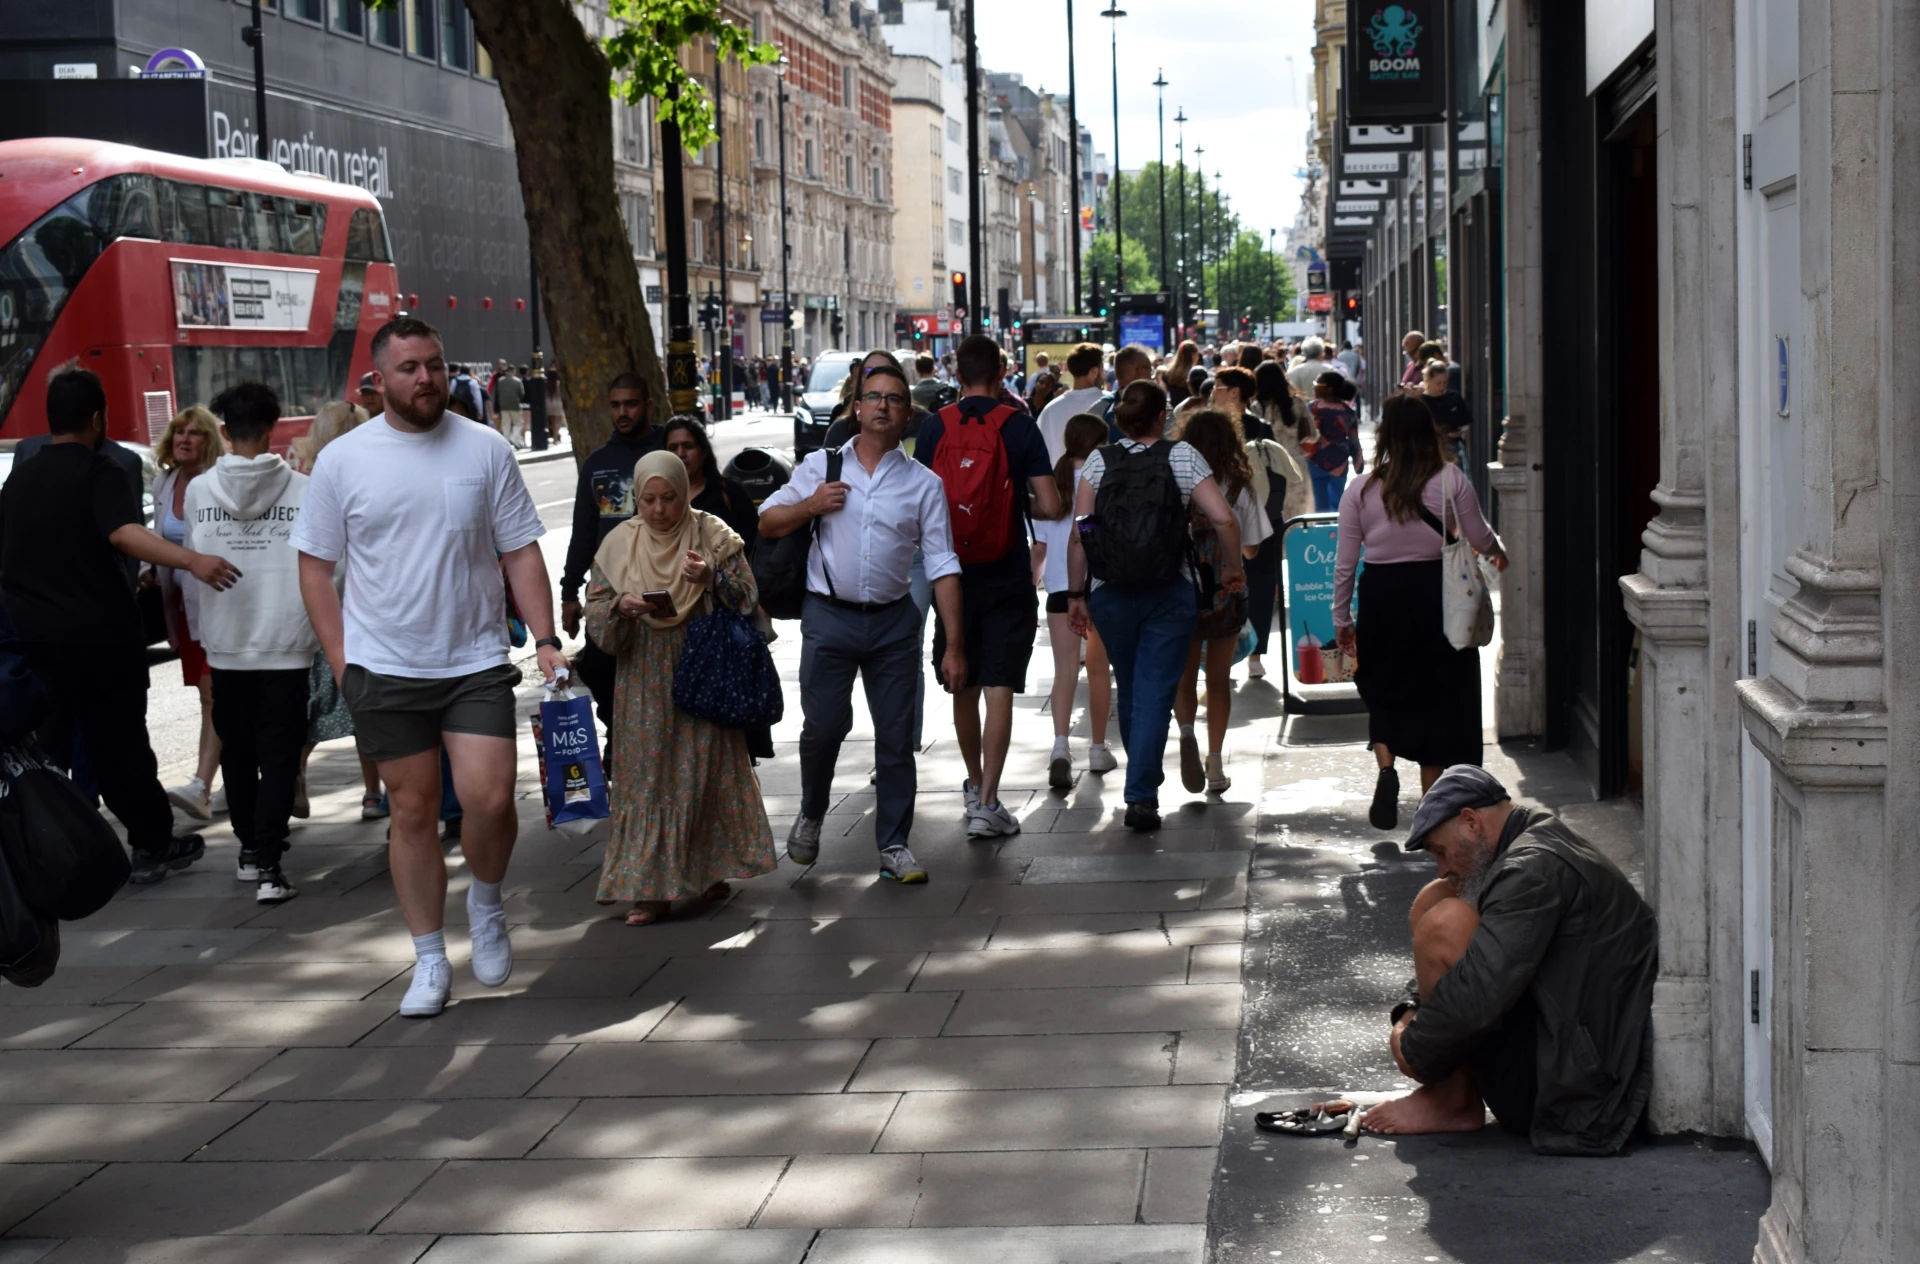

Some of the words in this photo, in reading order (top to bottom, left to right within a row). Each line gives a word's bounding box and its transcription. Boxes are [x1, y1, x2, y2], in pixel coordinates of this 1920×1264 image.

[1369, 58, 1420, 72] BOOM
[344, 146, 394, 199] retail.
[1346, 163, 1397, 171] RESERVED
[253, 506, 300, 522] OJEC
[1304, 544, 1337, 564] Cre
[1295, 582, 1323, 591] Bubble
[552, 728, 588, 748] M&S
[570, 765, 580, 778] G
